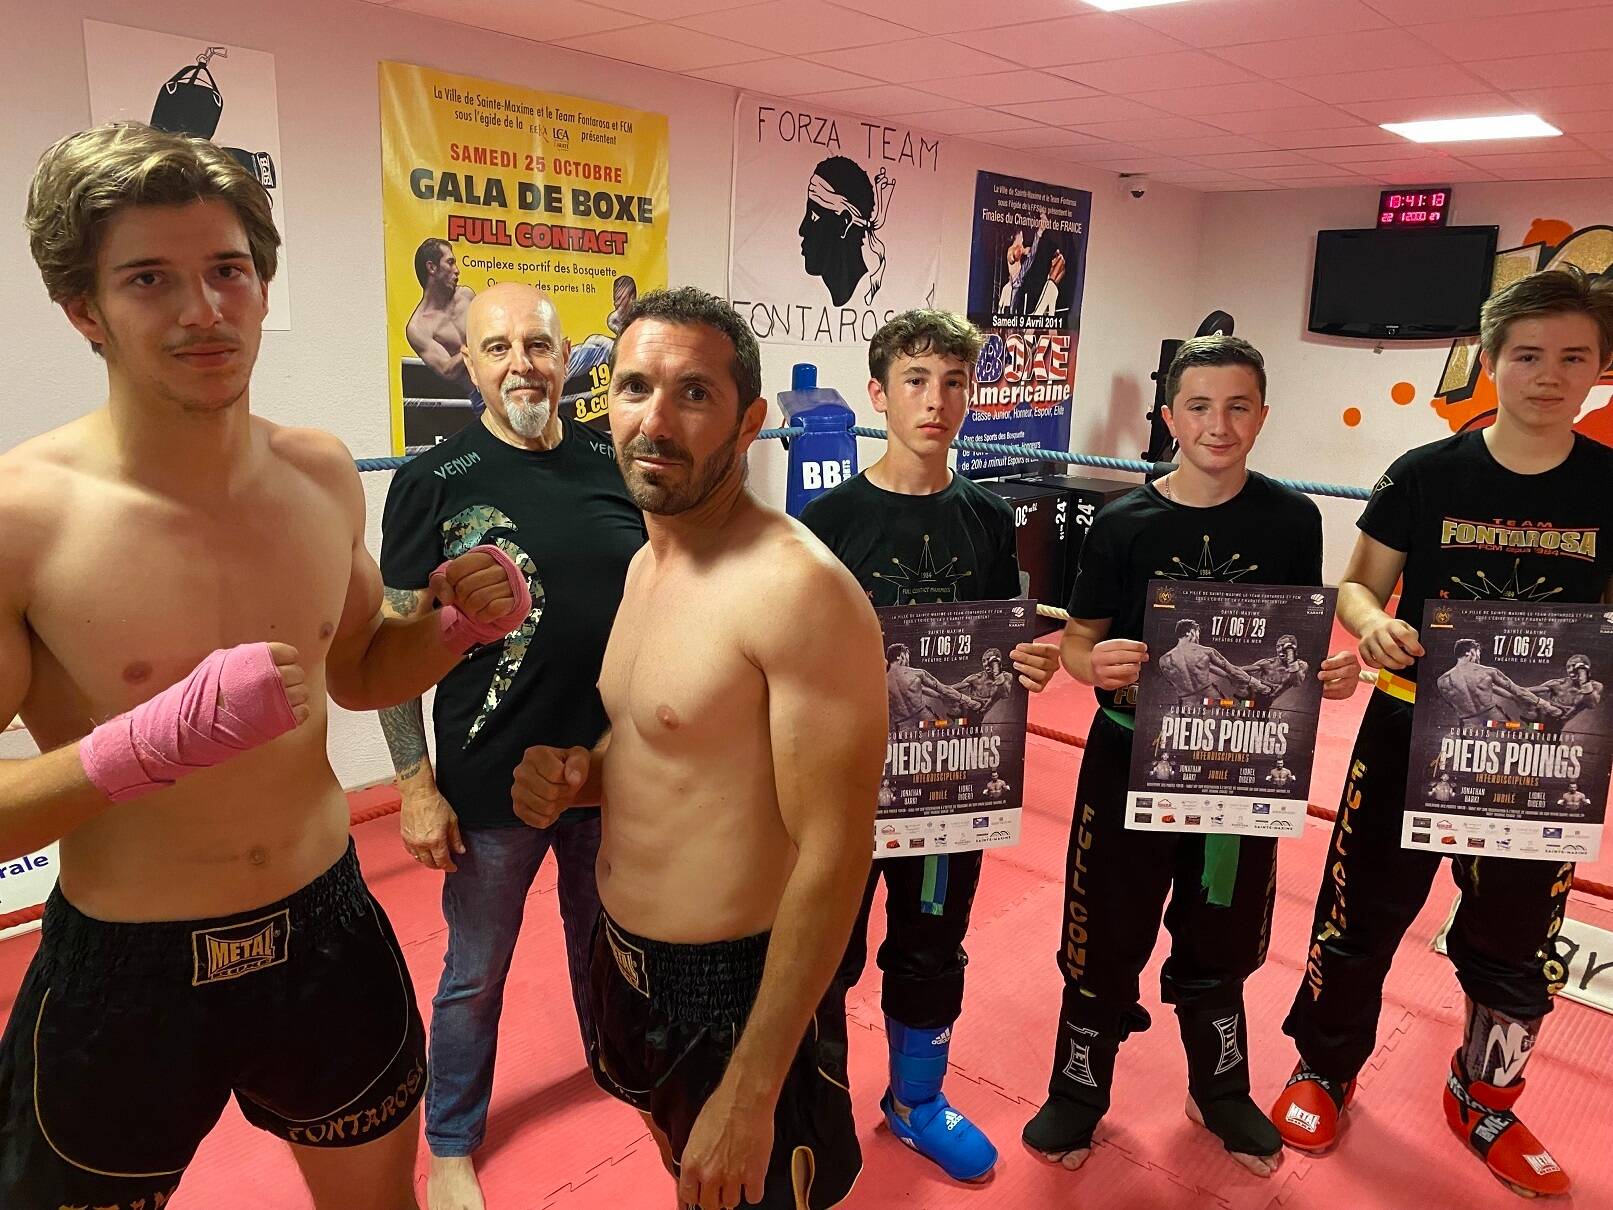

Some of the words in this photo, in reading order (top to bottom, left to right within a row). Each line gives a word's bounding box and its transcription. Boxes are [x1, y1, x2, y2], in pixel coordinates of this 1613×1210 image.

[434, 86, 442, 99] La
[445, 88, 461, 103] Ville
[465, 92, 474, 105] de
[537, 106, 544, 117] et
[546, 106, 552, 119] le
[556, 107, 575, 123] Team
[578, 113, 609, 129] Fontarosa
[620, 119, 632, 134] FCM
[455, 110, 472, 122] sous
[504, 115, 513, 128] de
[516, 117, 523, 129] la
[581, 130, 616, 145] présentent
[758, 106, 841, 150] FORZA
[860, 122, 939, 172] TEAM
[450, 143, 518, 169] SAMEDI
[525, 154, 546, 173] 25
[553, 158, 622, 184] OCTOBRE
[410, 168, 508, 209] GALA
[518, 181, 563, 214] DE
[572, 188, 654, 224] BOXE
[448, 214, 512, 248] FULL
[515, 222, 628, 256] CONTACT
[982, 208, 1004, 223] Finales
[1006, 213, 1013, 224] du
[1053, 219, 1060, 230] de
[1060, 220, 1082, 234] FRANCE
[462, 256, 514, 272] Complexe
[517, 260, 550, 274] sportif
[554, 262, 570, 274] des
[573, 264, 617, 278] Bosquette
[535, 282, 551, 292] des
[554, 283, 578, 294] portes
[582, 284, 596, 294] 18h
[992, 316, 1018, 328] Samedi
[1020, 316, 1024, 327] 9
[1026, 316, 1044, 328] Avril
[1045, 318, 1062, 328] 2011
[975, 334, 1070, 382] BOXE
[575, 398, 586, 418] 8
[972, 410, 991, 422] classe
[590, 440, 616, 460] VEN
[984, 432, 998, 442] Sports
[434, 451, 480, 480] VENUM
[802, 460, 842, 490] BB
[962, 463, 970, 471] de
[971, 459, 982, 470] 20h
[988, 457, 1006, 468] minuit
[1441, 520, 1597, 558] FONTAROSA
[1492, 518, 1552, 528] TEAM
[1161, 716, 1216, 752] PIEDS
[1218, 719, 1289, 755] POINGS
[882, 740, 932, 776] PIEDS
[936, 736, 1000, 772] POINGS
[1440, 738, 1500, 774] PIEDS
[1504, 742, 1583, 779] POINGS
[0, 856, 48, 879] rale
[210, 928, 272, 972] METAL
[1067, 901, 1088, 980] CONT
